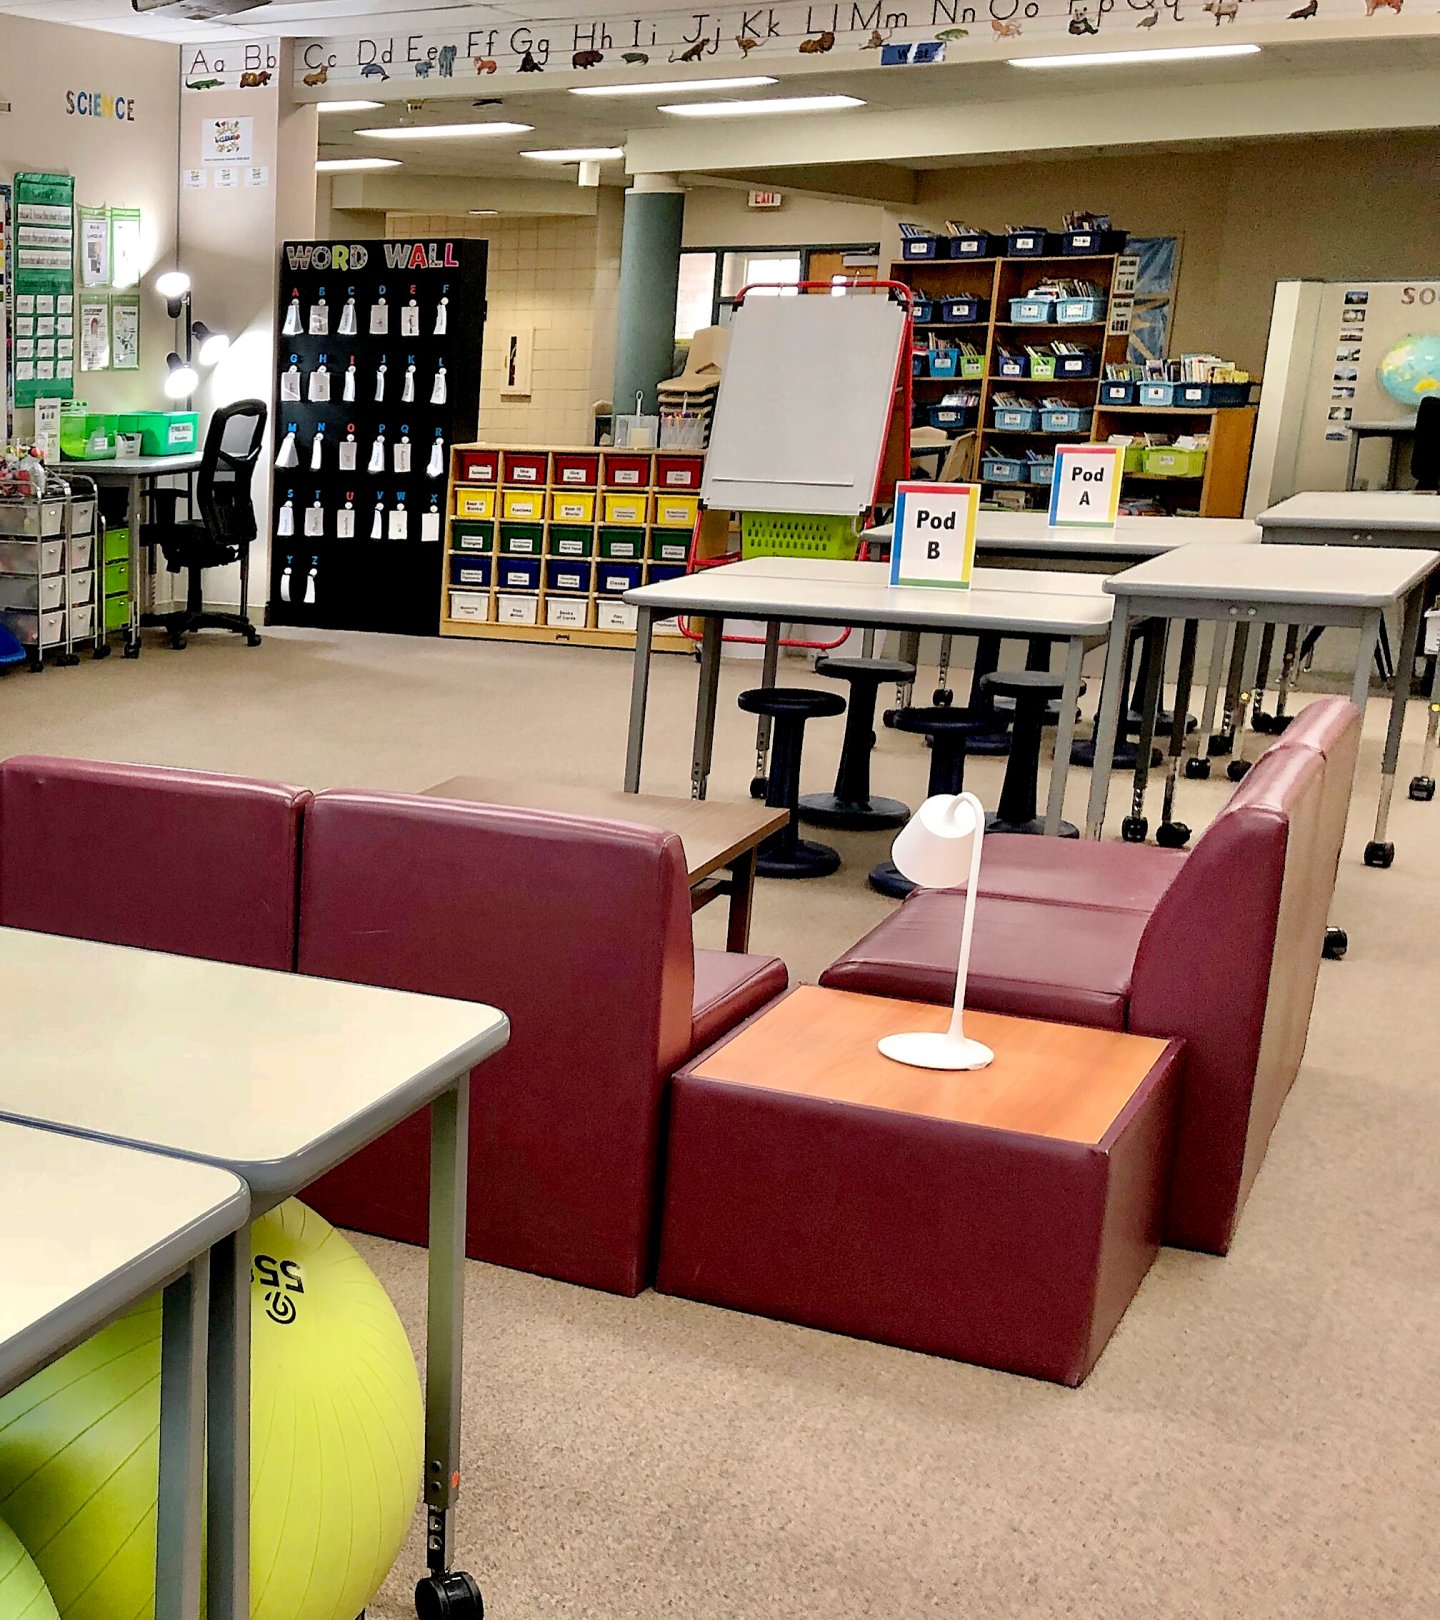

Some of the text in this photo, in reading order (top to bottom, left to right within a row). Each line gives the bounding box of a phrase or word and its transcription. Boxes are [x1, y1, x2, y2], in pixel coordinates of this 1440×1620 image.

[190, 49, 225, 74] Aa
[245, 44, 277, 70] Bb
[304, 44, 337, 69] Cc
[359, 37, 393, 65] Dd
[407, 35, 437, 62] Ee
[510, 28, 549, 65] Gg
[742, 9, 780, 38] Kk
[851, 1, 907, 30] Mm
[66, 90, 134, 121] SCIENCE
[754, 193, 774, 204] EXIT
[286, 243, 459, 271] WORD WALL
[292, 285, 449, 297] A B C D E F
[1401, 287, 1440, 305] SO
[290, 354, 445, 367] G H I J K L
[288, 423, 442, 437] M N O P Q R
[1071, 467, 1104, 482] Pod
[287, 489, 438, 503] S T U V W X
[1079, 491, 1090, 506] A
[916, 509, 956, 530] Pod
[927, 541, 940, 559] B
[286, 555, 318, 565] Y Z
